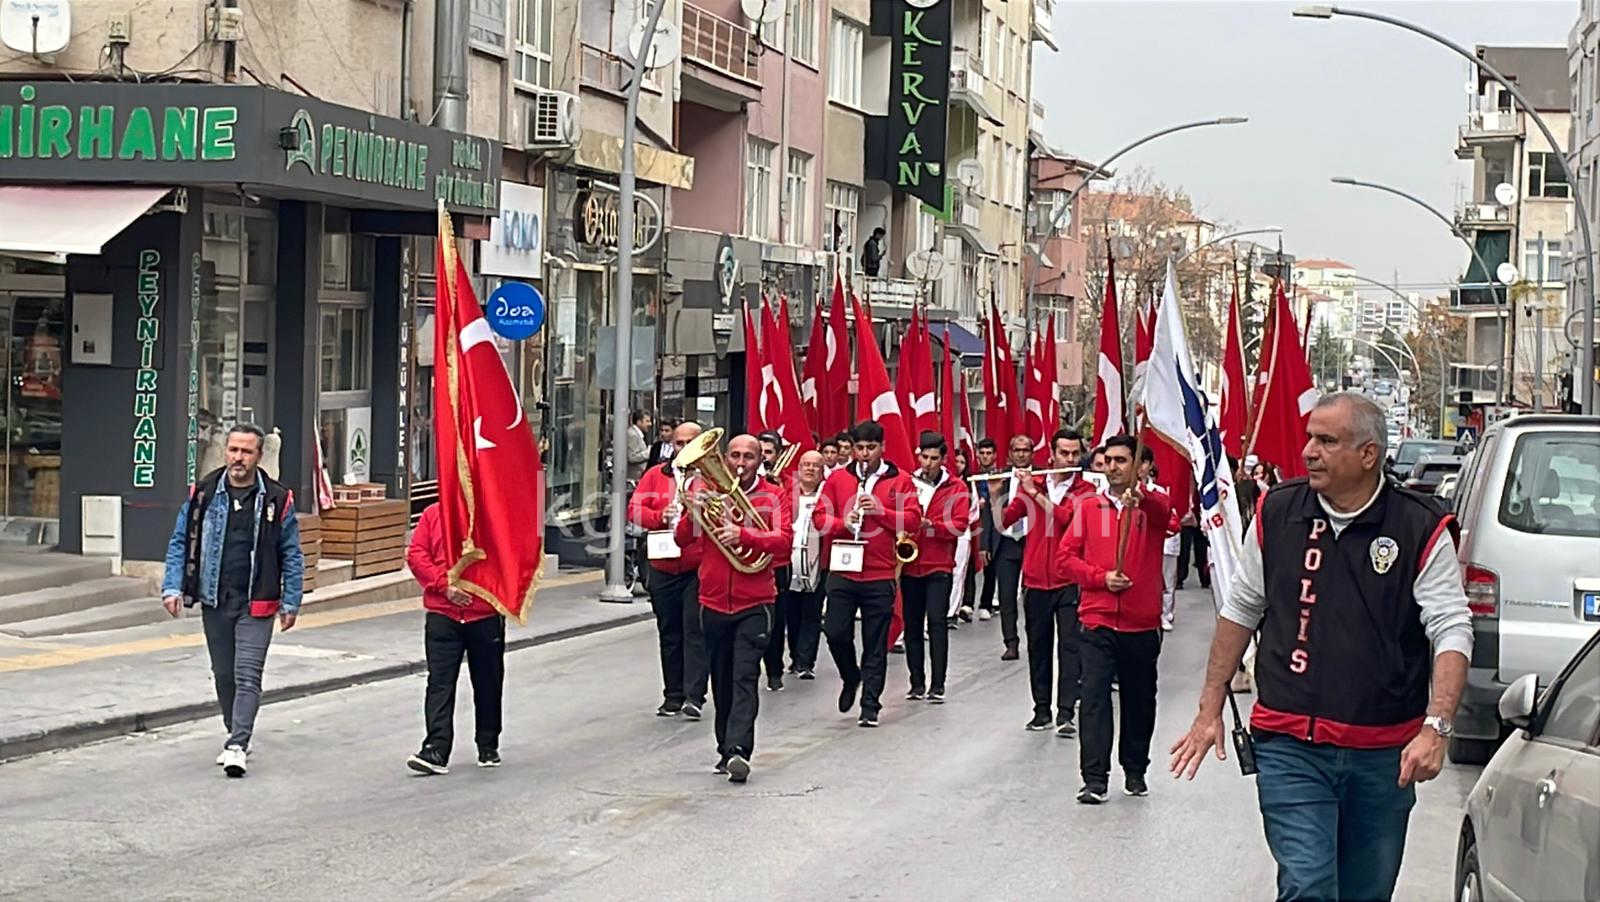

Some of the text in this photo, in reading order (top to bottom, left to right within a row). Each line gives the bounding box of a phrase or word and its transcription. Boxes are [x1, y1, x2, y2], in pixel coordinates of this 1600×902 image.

[320, 115, 428, 191] PEYNİRHANE
[899, 11, 942, 186] KERVAN
[133, 250, 160, 488] PEYNİRHANE
[1288, 518, 1328, 674] POLİS
